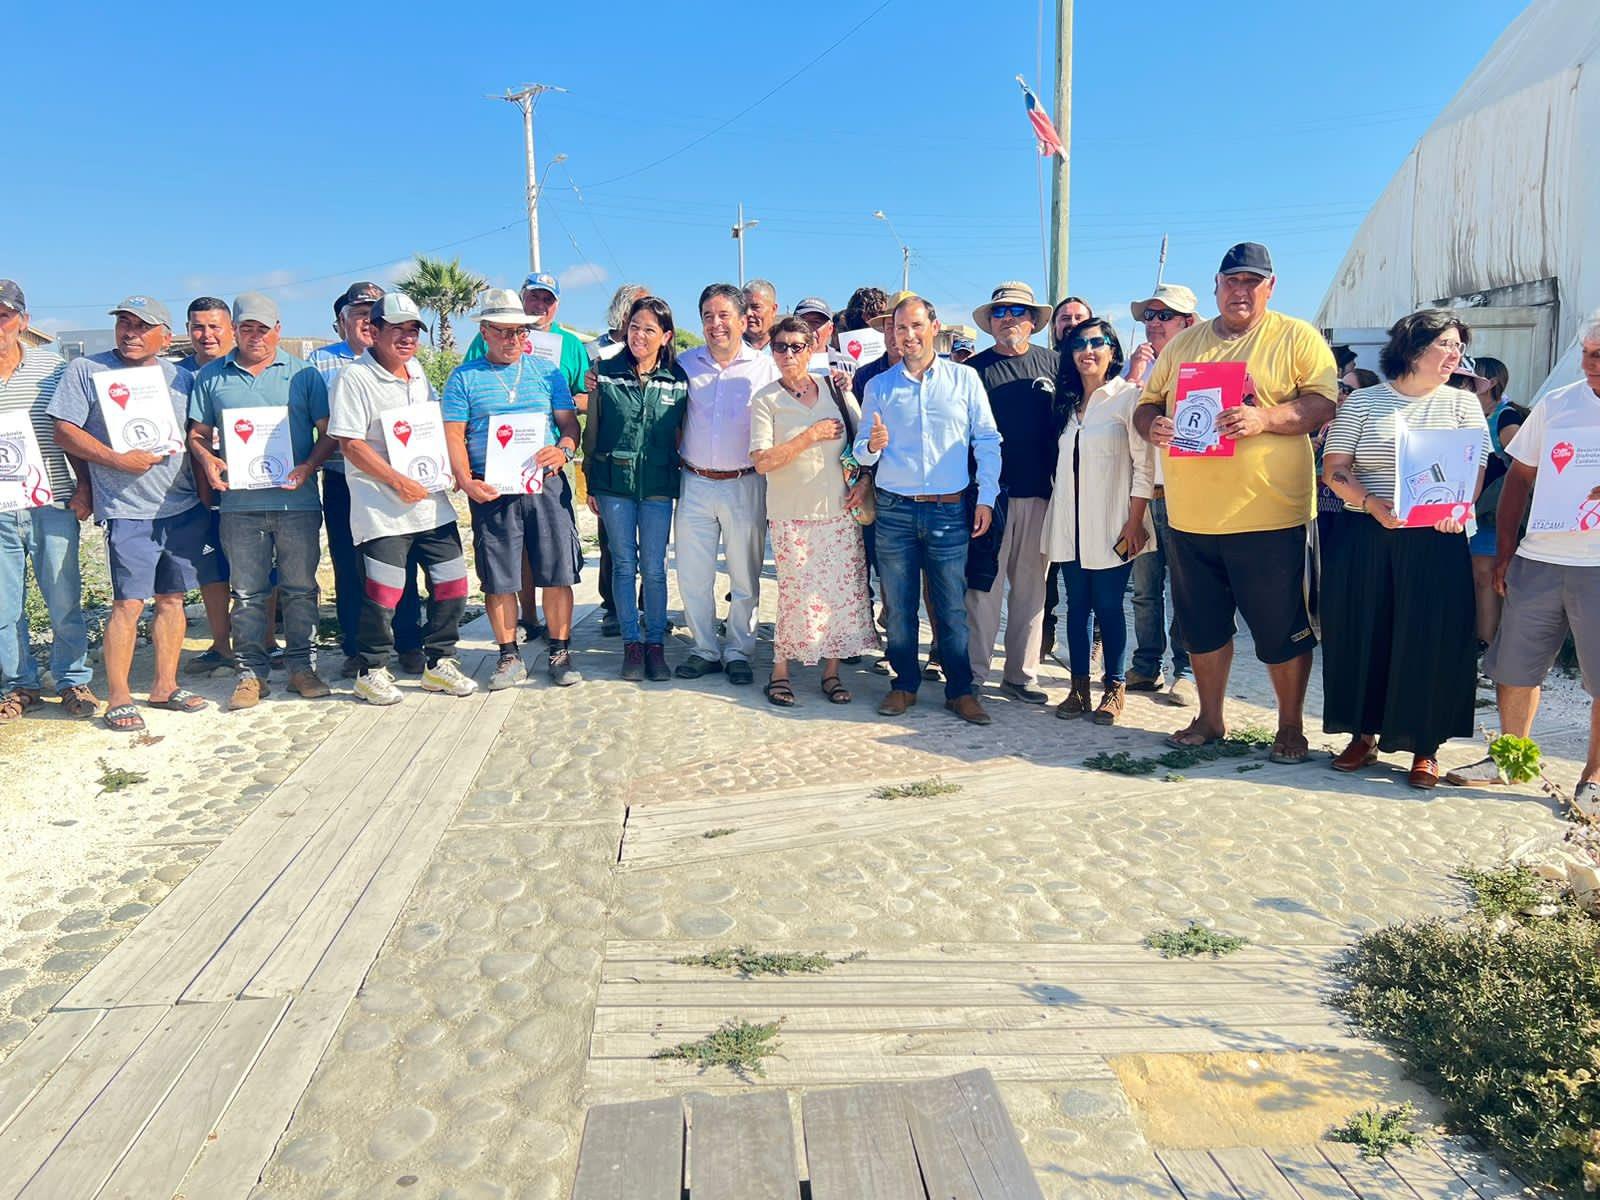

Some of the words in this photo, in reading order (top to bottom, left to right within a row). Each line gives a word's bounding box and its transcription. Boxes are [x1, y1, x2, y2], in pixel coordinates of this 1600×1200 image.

[1188, 412, 1201, 428] R
[133, 424, 149, 440] R
[260, 461, 273, 474] R
[417, 462, 429, 477] R
